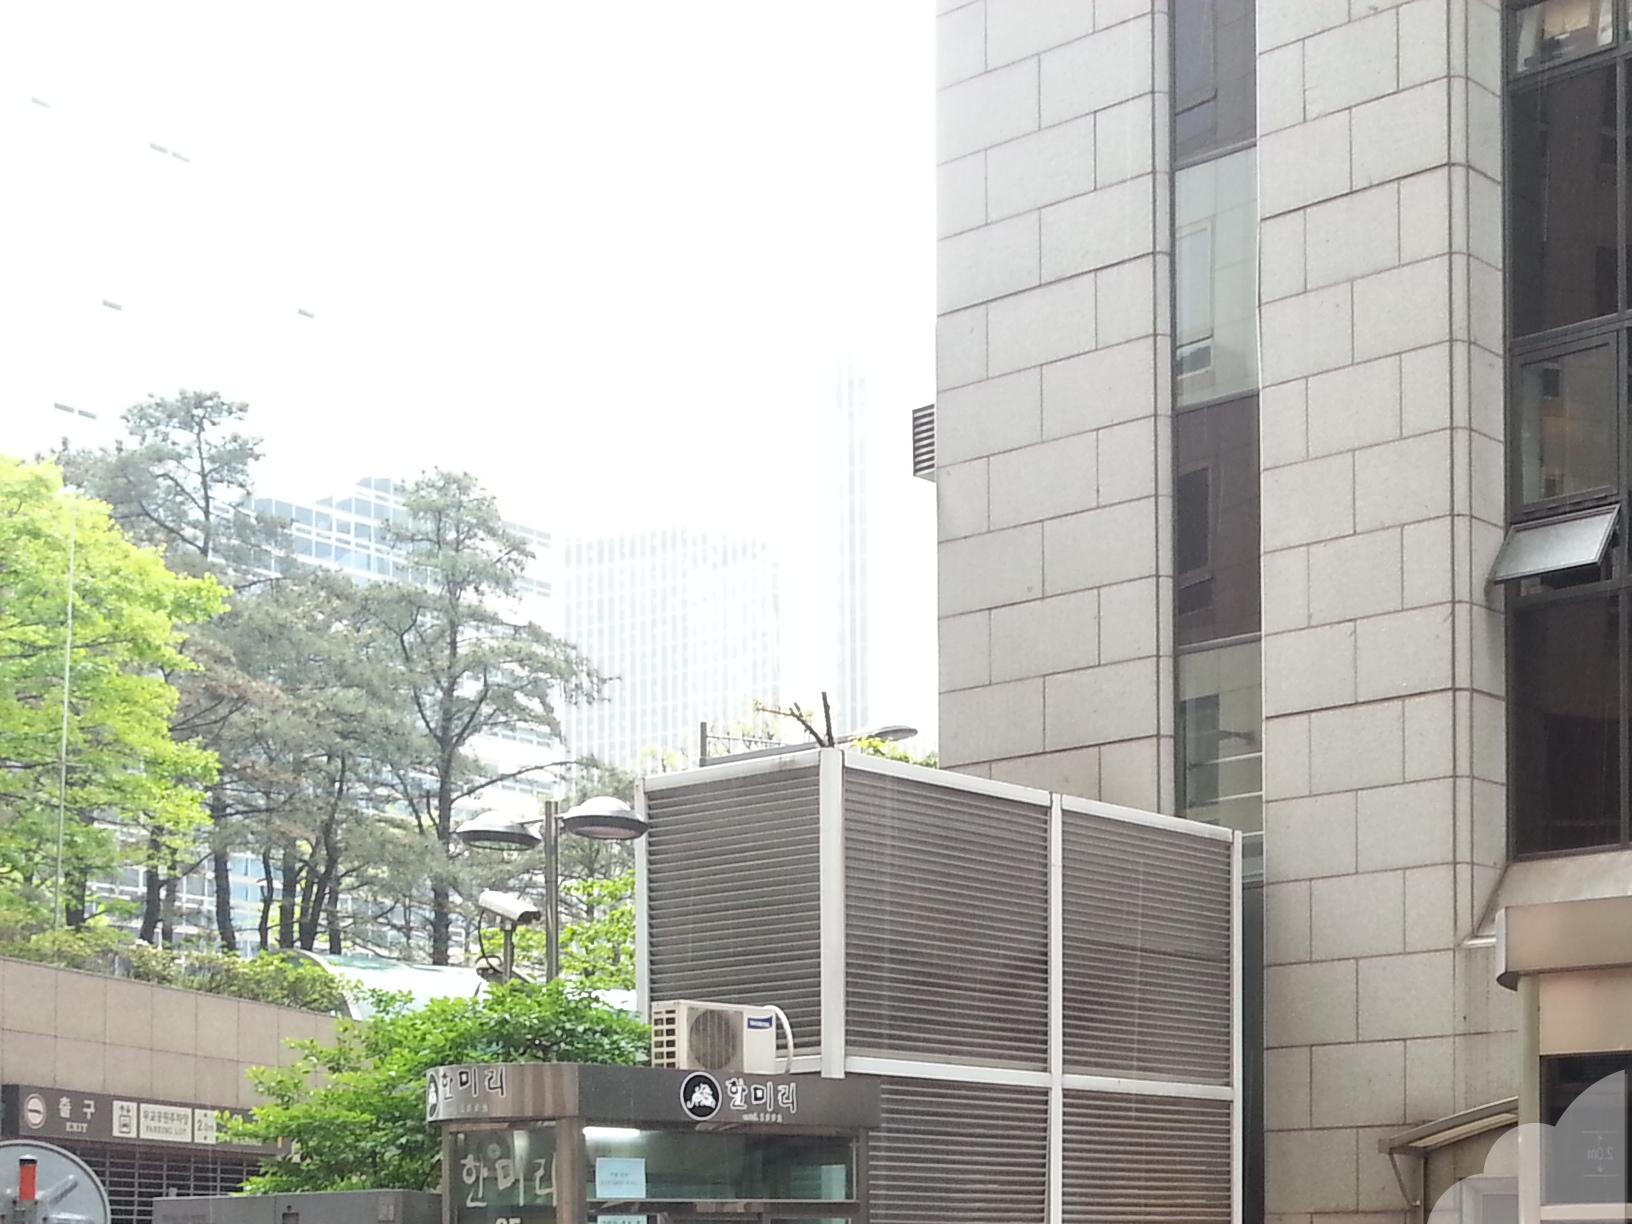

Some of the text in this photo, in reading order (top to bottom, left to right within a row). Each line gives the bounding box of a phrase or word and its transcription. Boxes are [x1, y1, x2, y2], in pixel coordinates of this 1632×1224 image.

[725, 1077, 797, 1114] 한미리
[65, 1122, 88, 1134] EXIT
[460, 1152, 557, 1208] 한미리
